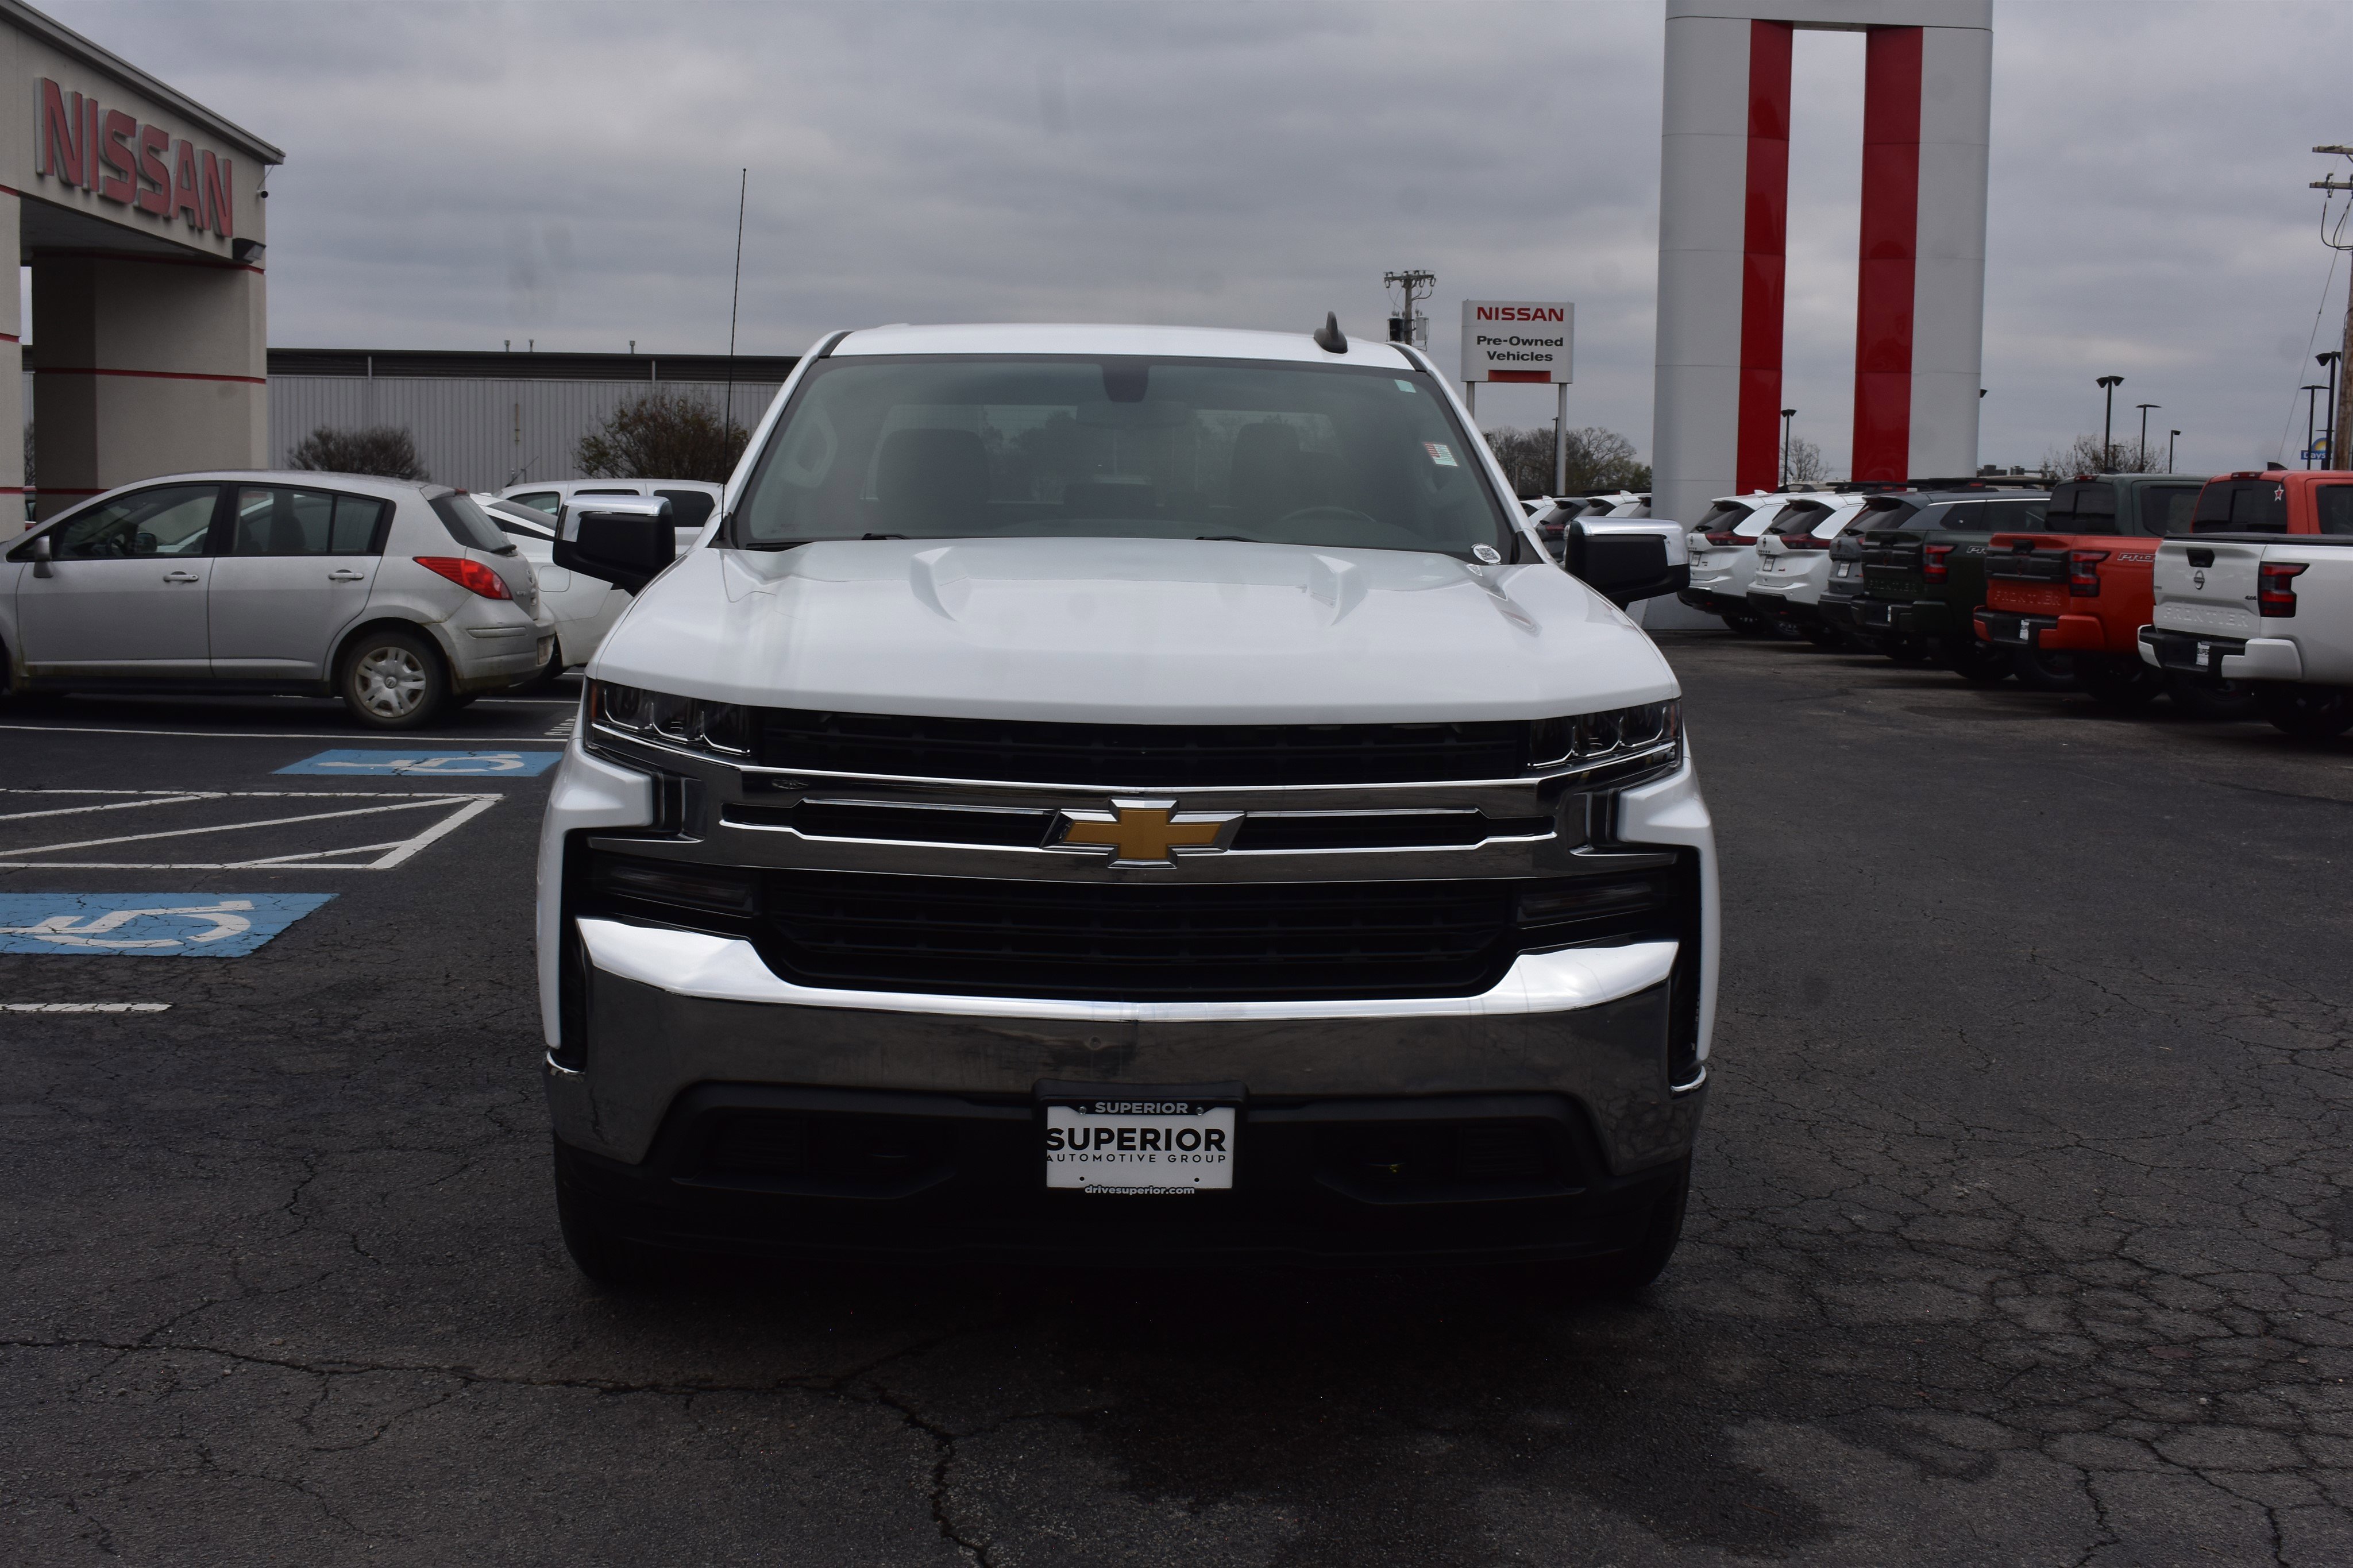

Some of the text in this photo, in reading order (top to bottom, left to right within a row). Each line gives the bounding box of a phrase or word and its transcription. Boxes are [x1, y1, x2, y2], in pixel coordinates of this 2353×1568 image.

[33, 77, 233, 237] NISSAN
[1477, 307, 1564, 322] NISSAN
[1477, 335, 1563, 346] Pre-Owned
[1487, 351, 1553, 361] Vehicles
[1993, 589, 2062, 607] FRONTIER
[2163, 605, 2249, 628] FRONTIER
[1094, 1102, 1189, 1114] SUPERIOR
[1047, 1127, 1226, 1152] SUPERIOR
[1047, 1153, 1226, 1163] AUTOMOTIVE GROUP
[1085, 1184, 1195, 1195] drivesuperior.com
